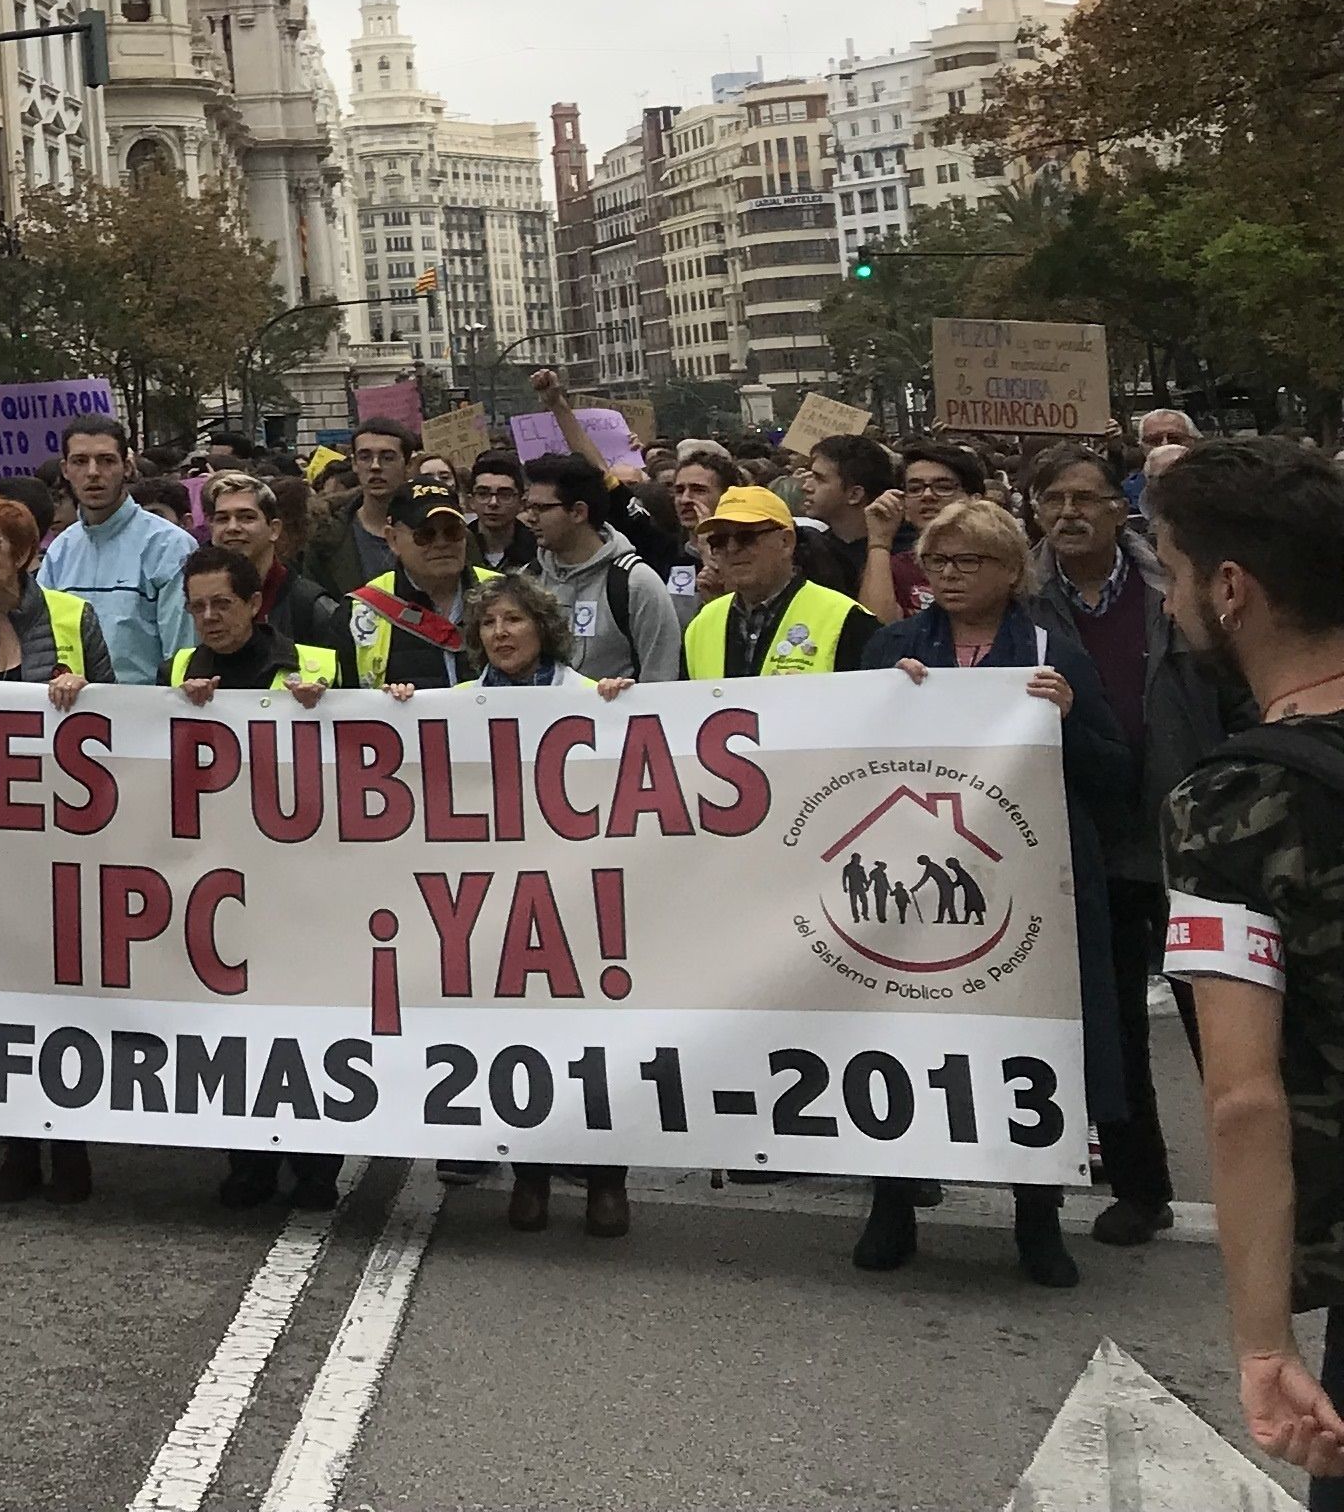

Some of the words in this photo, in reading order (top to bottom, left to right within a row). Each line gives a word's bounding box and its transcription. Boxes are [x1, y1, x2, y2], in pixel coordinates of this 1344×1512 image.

[1, 390, 110, 420] QUITARON
[946, 399, 1078, 429] PATRIARCADO
[169, 707, 773, 845] PUBLICAS
[783, 766, 868, 848] Coordinadora
[868, 759, 933, 776] Estatal
[935, 764, 968, 783] por
[968, 774, 985, 791] la
[984, 784, 1039, 849] Defensa
[53, 861, 250, 997] IPC
[370, 867, 635, 1037] ¡YA!
[793, 914, 814, 938] del
[811, 939, 878, 990] Sistema
[884, 979, 954, 1000] Público
[961, 977, 987, 995] de
[987, 914, 1044, 982] Pensiones
[423, 1043, 1067, 1149] 2011-2013
